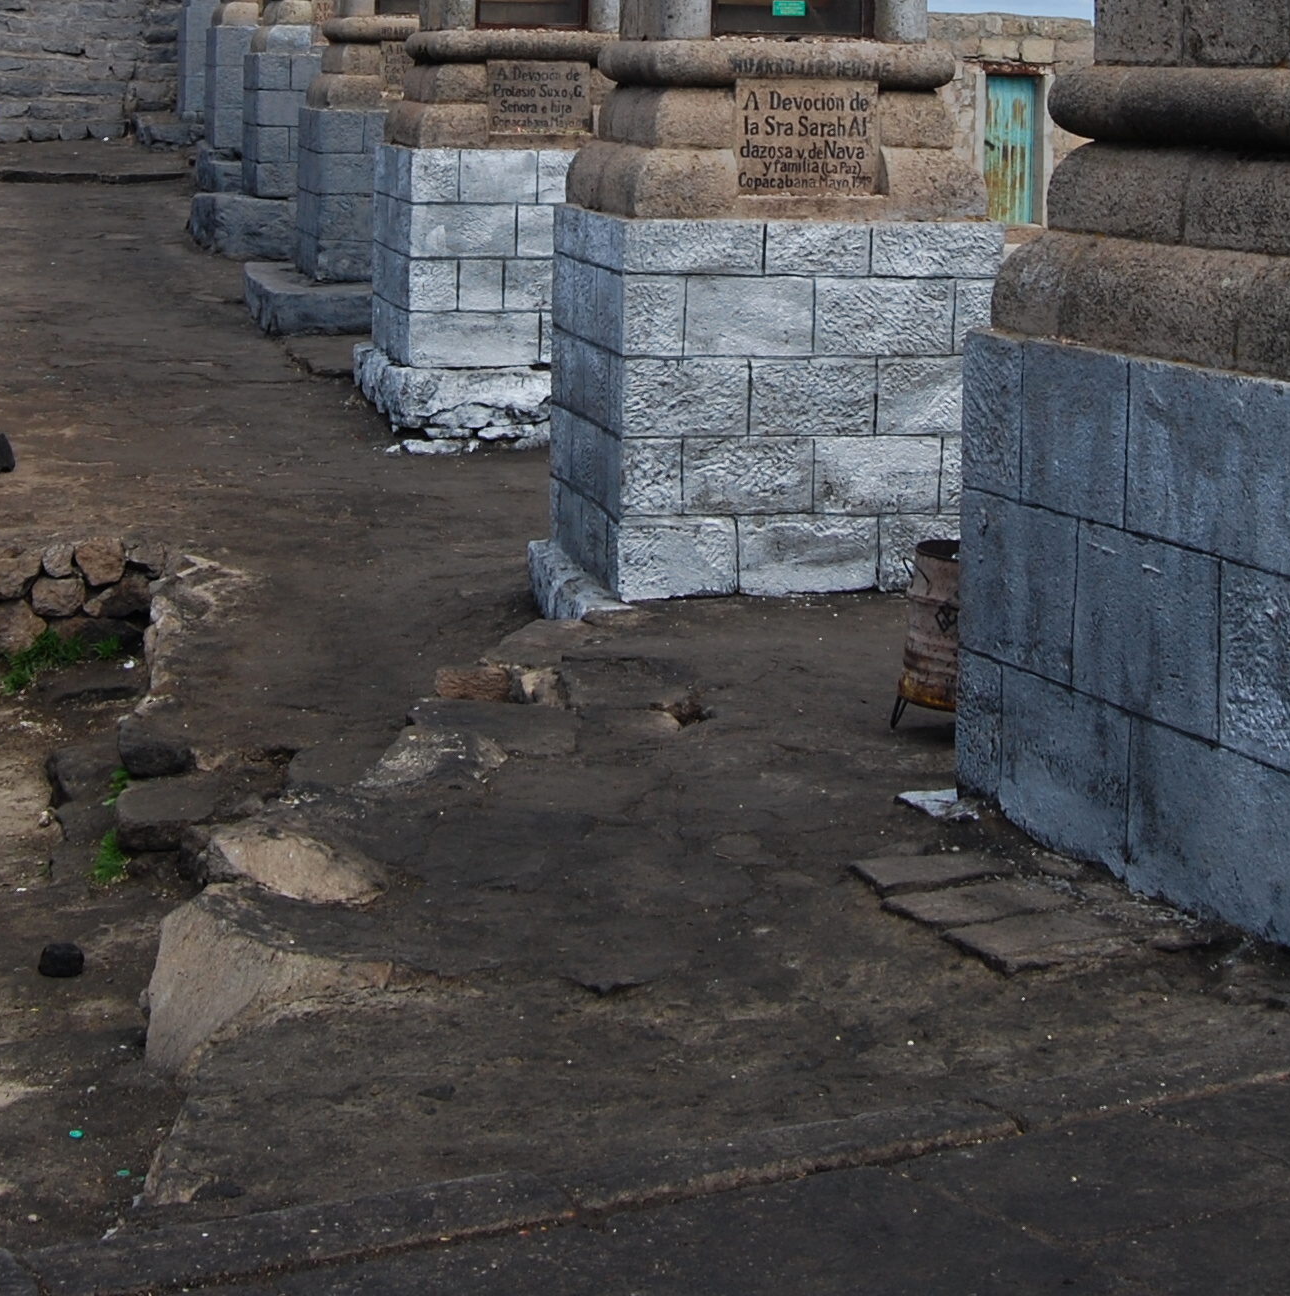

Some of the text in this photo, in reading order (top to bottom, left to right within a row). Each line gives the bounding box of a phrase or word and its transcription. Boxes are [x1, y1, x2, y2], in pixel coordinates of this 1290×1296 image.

[566, 69, 580, 81] de
[550, 100, 572, 118] hija
[742, 90, 870, 112] A Devoción de
[743, 115, 760, 136] la
[764, 115, 794, 137] Sra
[798, 115, 846, 137] Sarah
[740, 139, 793, 159] dazosa
[808, 142, 823, 160] de
[824, 139, 865, 160] Nava
[763, 161, 772, 177] y
[773, 158, 820, 174] familia
